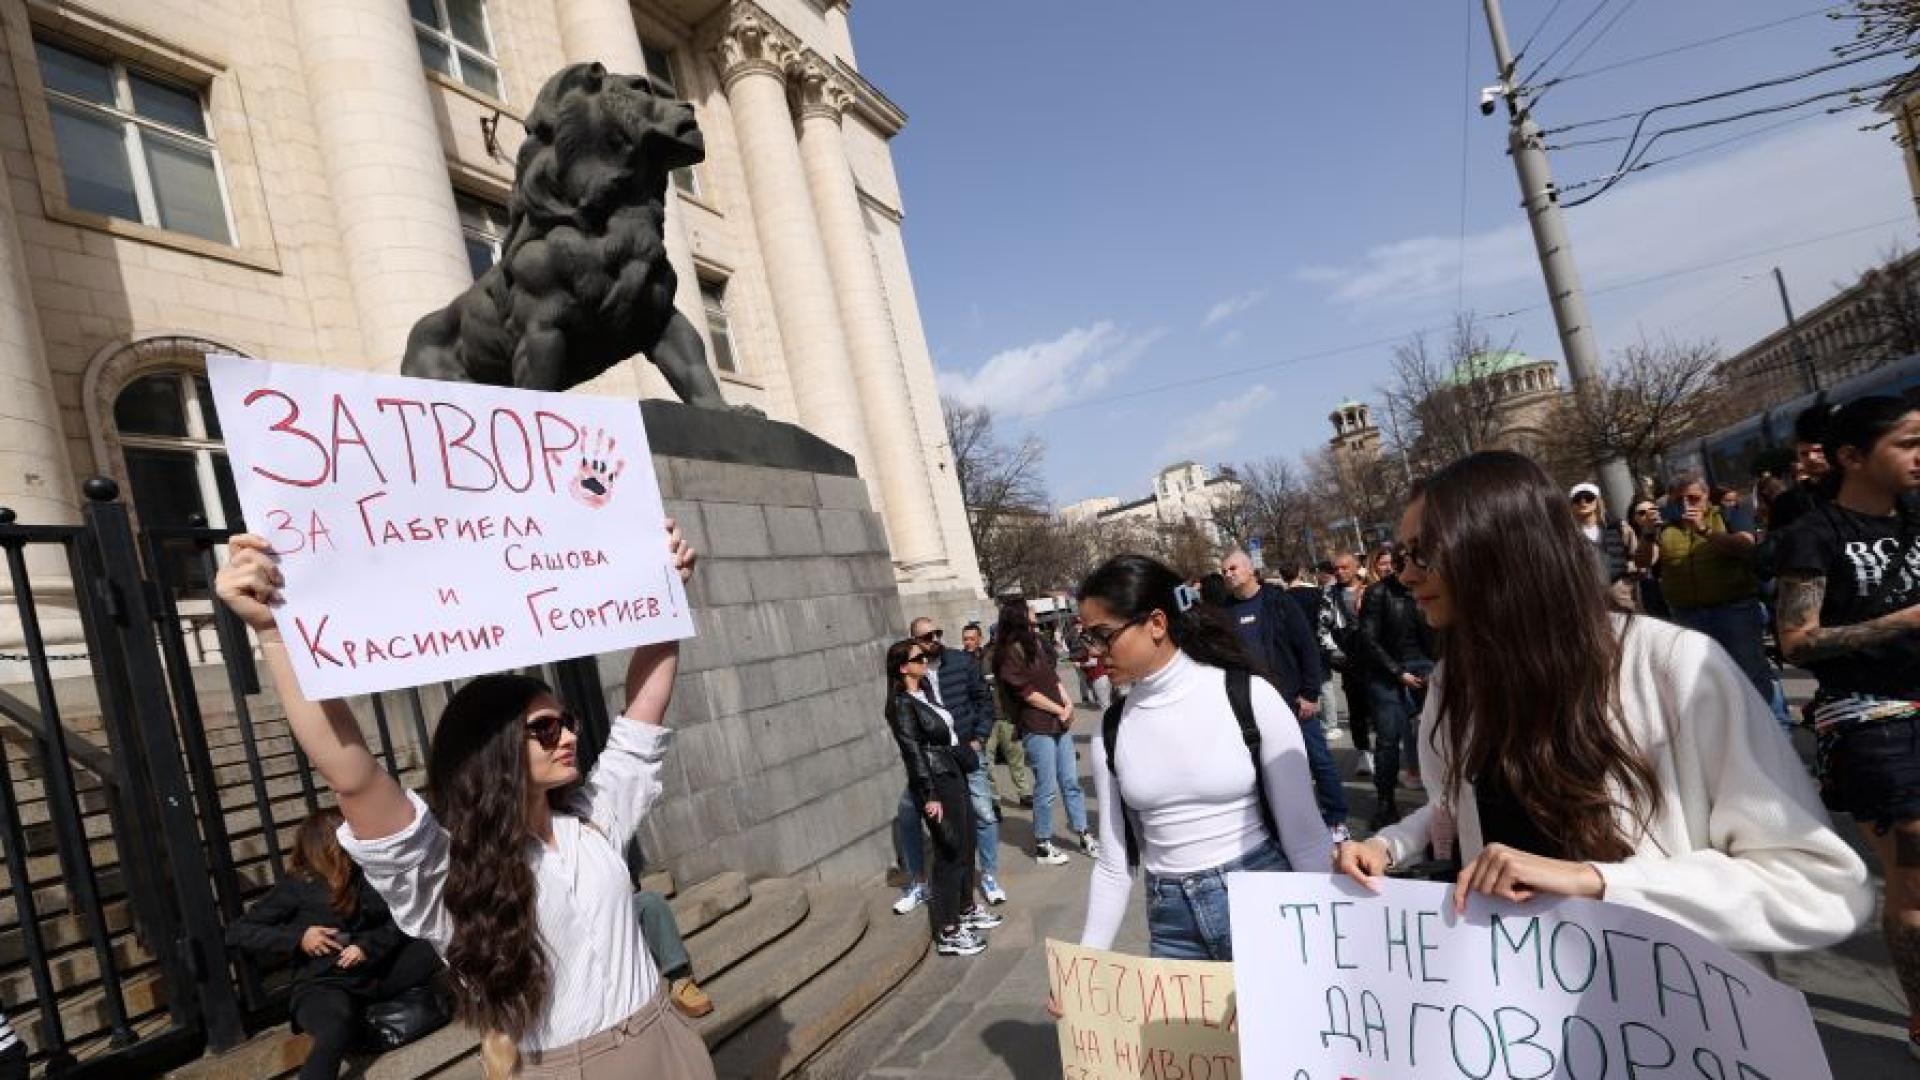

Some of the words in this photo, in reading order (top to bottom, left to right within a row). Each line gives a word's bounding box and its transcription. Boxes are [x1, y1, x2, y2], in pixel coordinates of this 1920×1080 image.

[244, 389, 579, 494] ЗАТВОР
[265, 509, 334, 556] ЗА
[1279, 901, 1358, 970] ТЕ
[1384, 905, 1449, 983] НЕ
[1491, 913, 1751, 1050] МОГАТ
[1319, 985, 1390, 1062] ДА
[1409, 1002, 1772, 1080] ГОВОР
